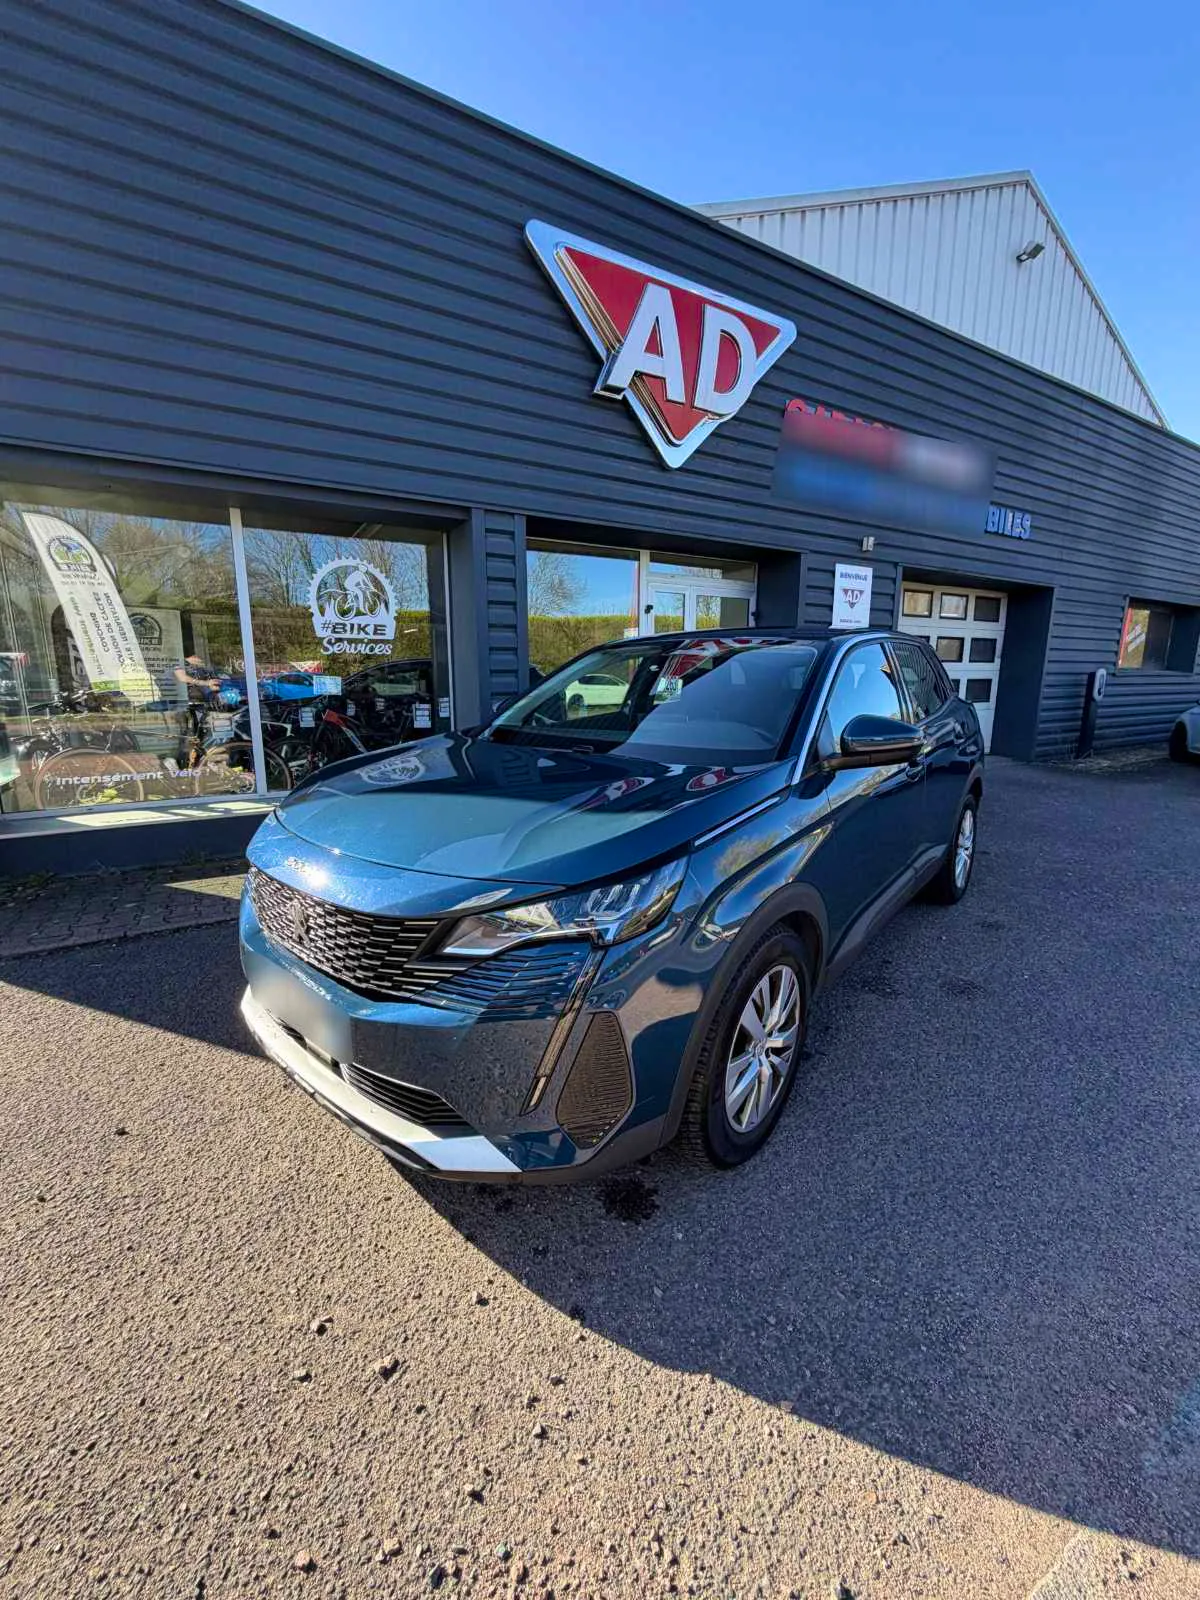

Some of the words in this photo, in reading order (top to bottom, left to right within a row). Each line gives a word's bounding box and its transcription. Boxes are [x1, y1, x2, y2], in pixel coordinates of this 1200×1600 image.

[604, 282, 758, 415] AD
[845, 589, 862, 603] AD
[320, 619, 387, 636] #BIKE
[320, 635, 393, 655] Services
